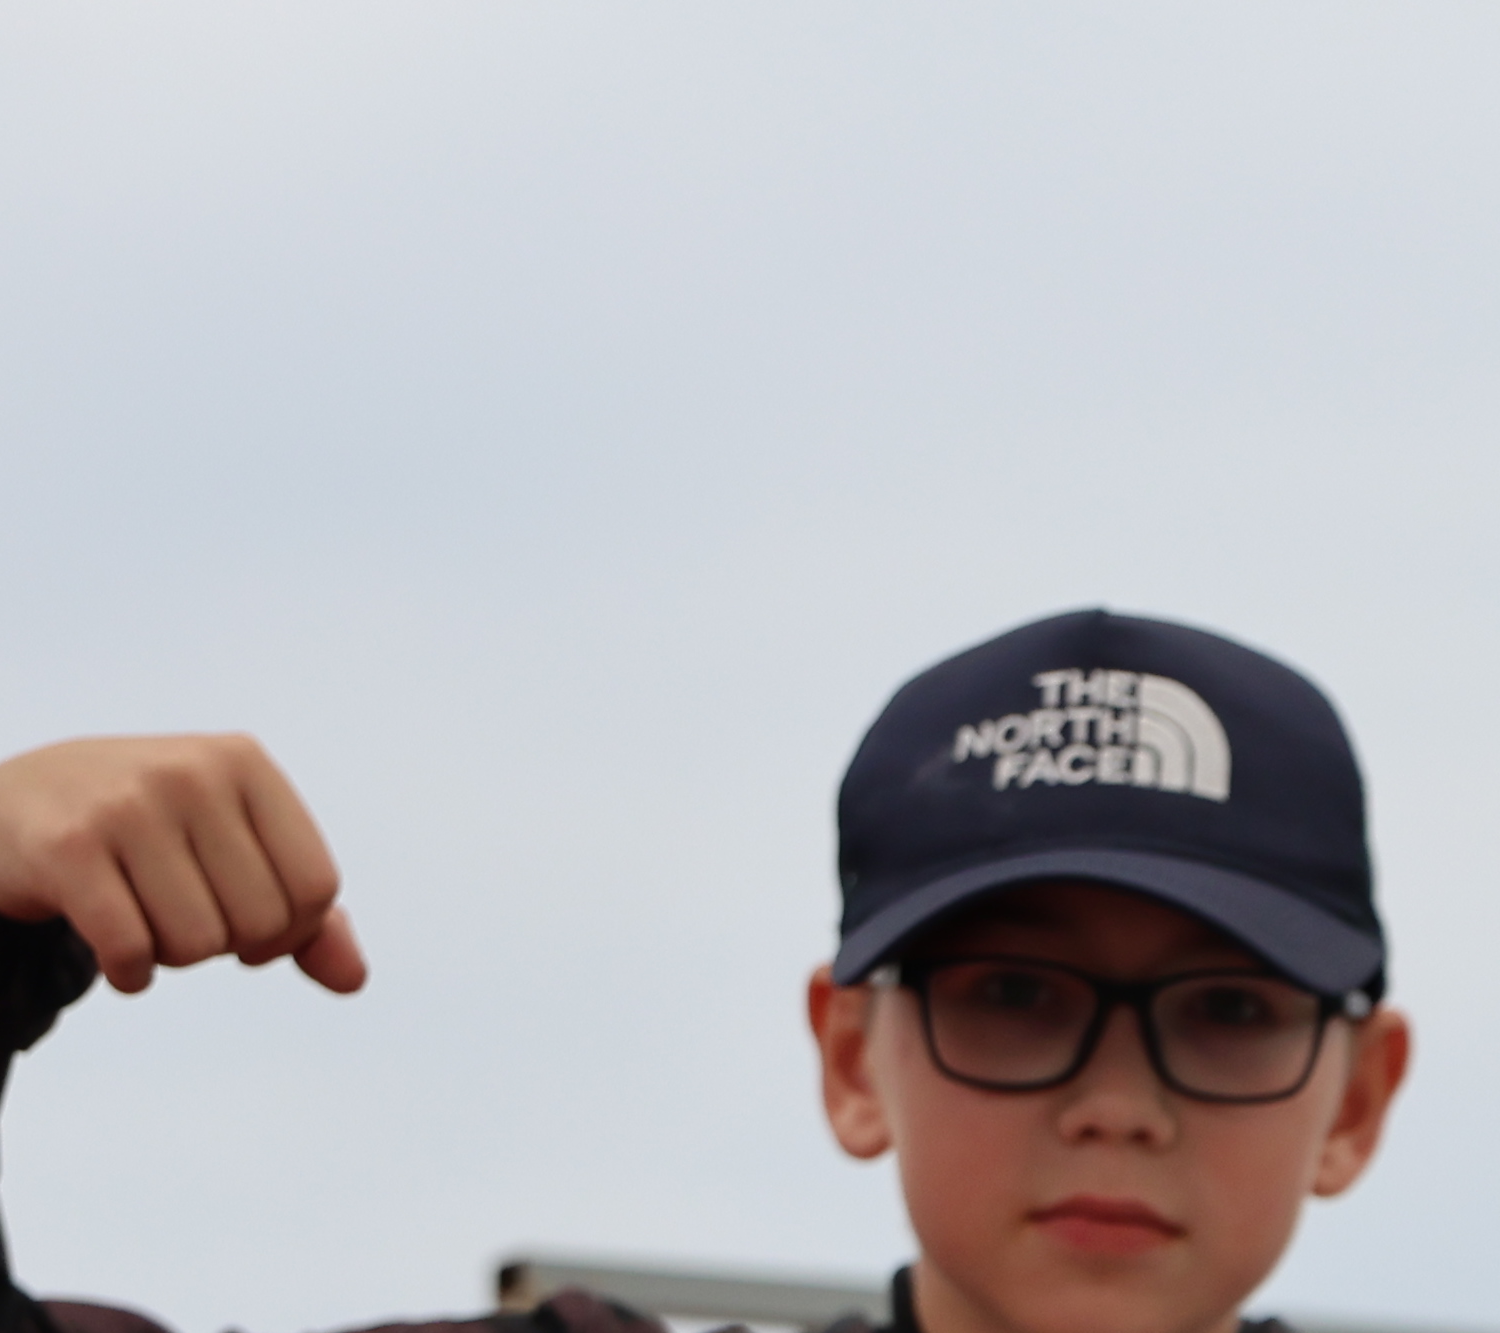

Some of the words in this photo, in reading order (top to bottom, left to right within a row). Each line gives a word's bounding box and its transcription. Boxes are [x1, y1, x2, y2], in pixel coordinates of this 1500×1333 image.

[1032, 667, 1138, 707] THE
[954, 704, 1138, 763] NORTH
[992, 743, 1133, 791] FACE
